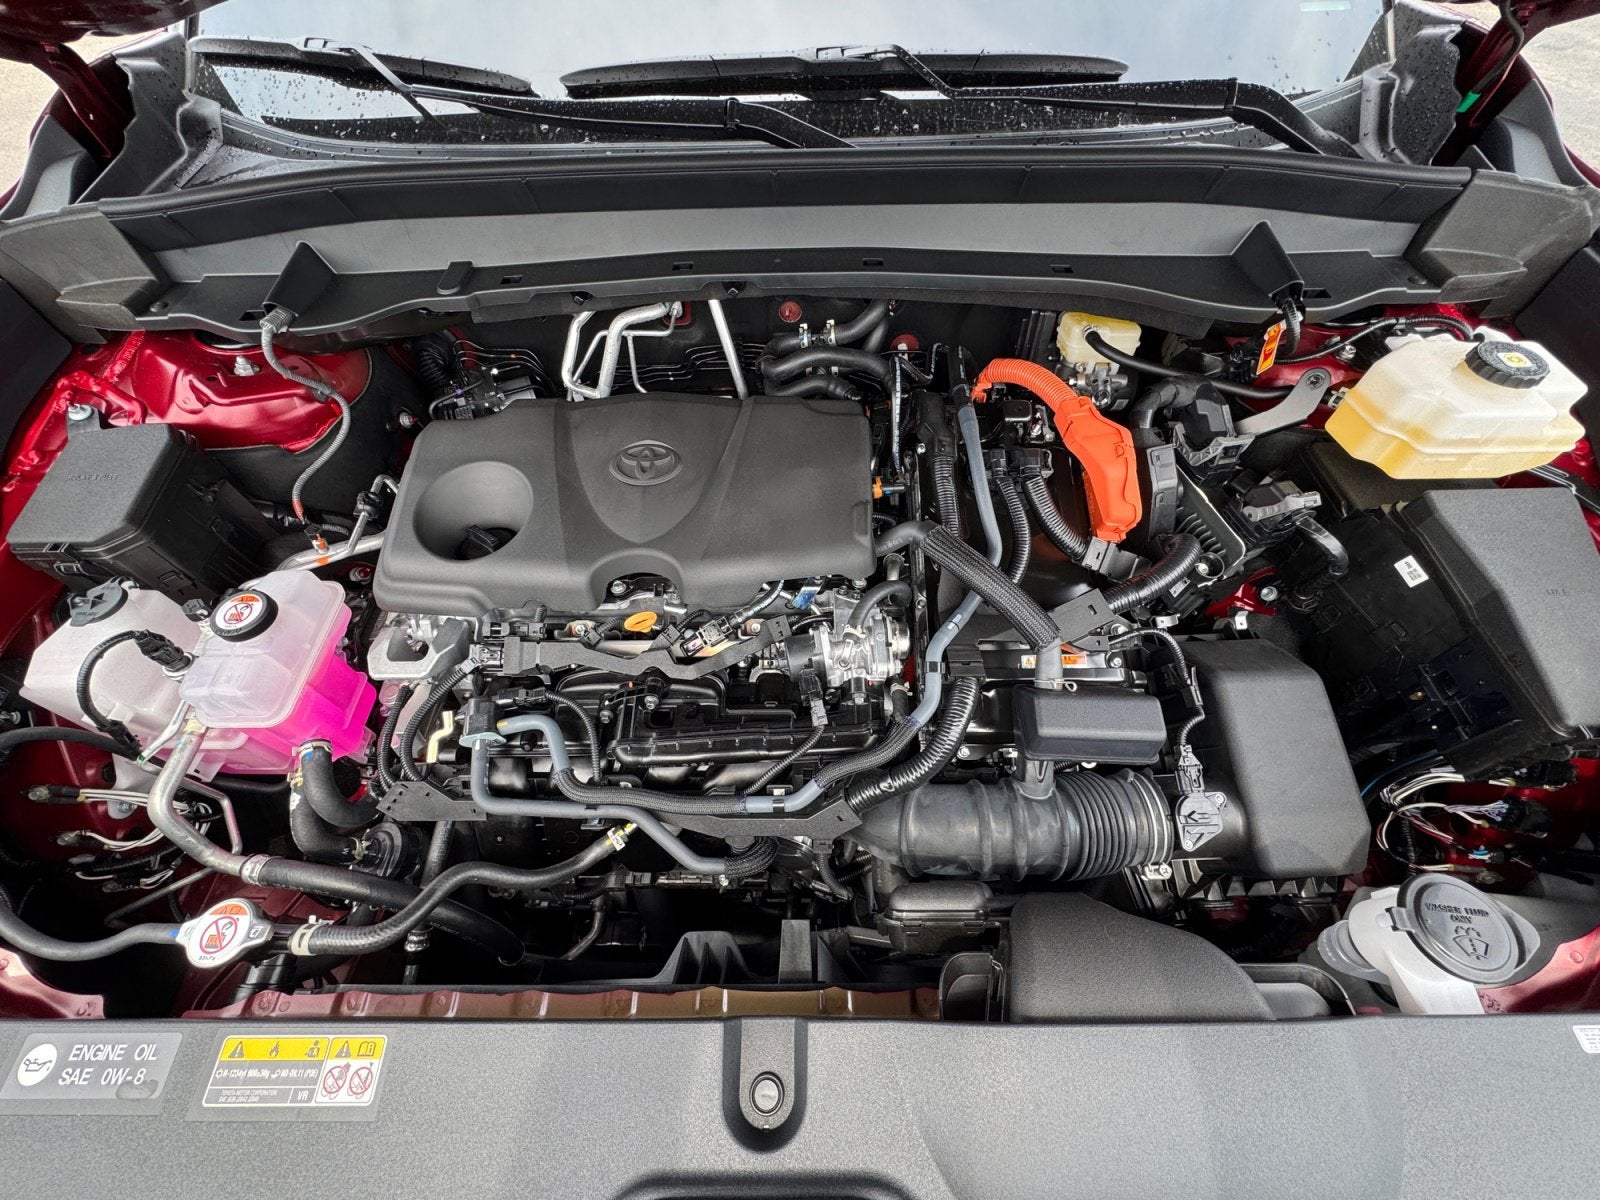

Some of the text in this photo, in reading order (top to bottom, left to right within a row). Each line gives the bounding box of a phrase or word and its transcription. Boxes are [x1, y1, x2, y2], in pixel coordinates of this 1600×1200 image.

[68, 1044, 158, 1061] ENGINE OIL
[58, 1067, 147, 1086] SAE 0W-8
[297, 1090, 309, 1101] VR
